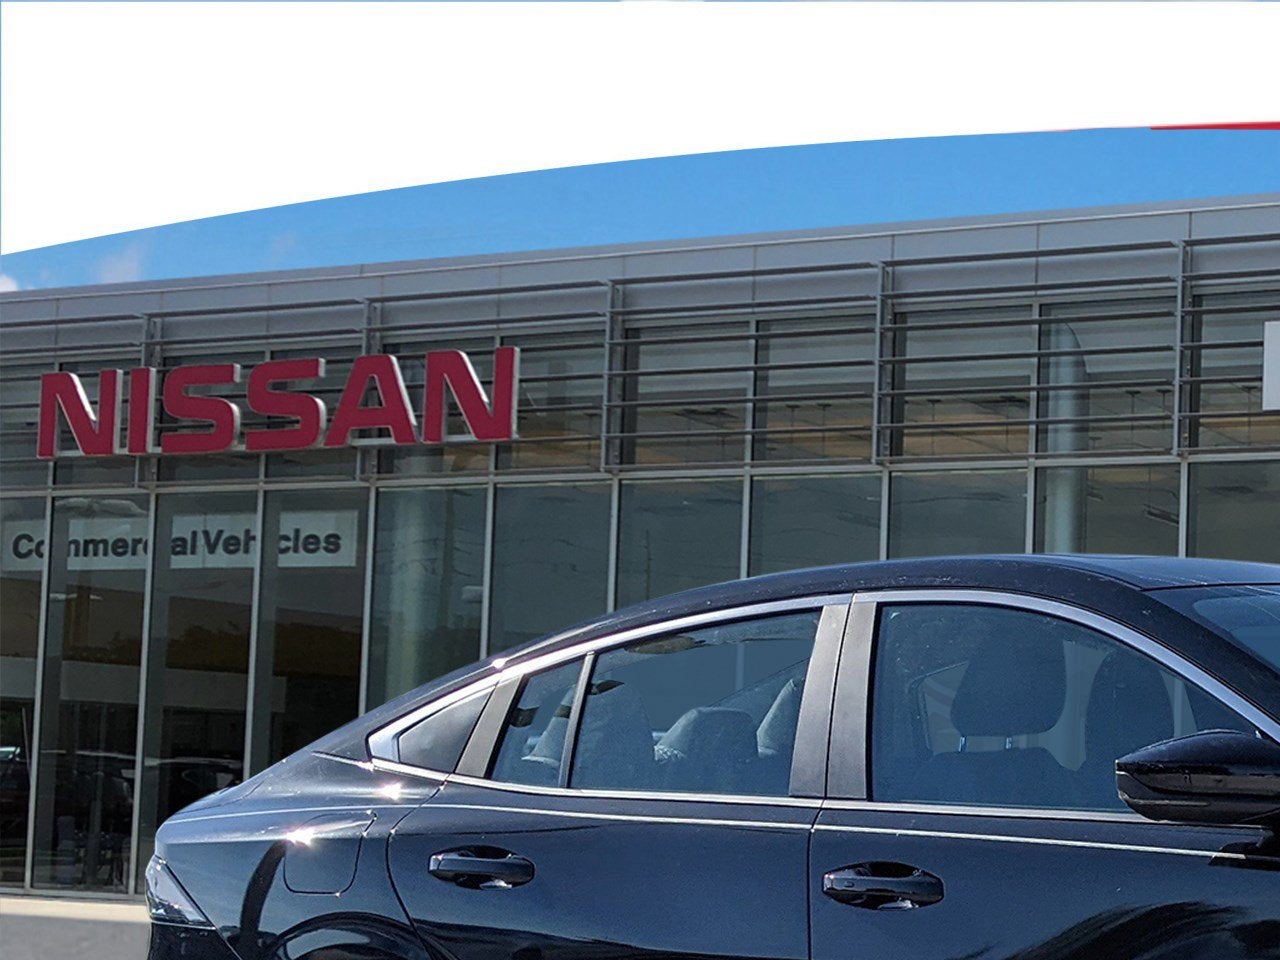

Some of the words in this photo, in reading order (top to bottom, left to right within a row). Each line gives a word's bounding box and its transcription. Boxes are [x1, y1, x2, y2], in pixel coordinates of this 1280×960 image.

[37, 346, 519, 458] NISSAN
[12, 530, 198, 558] Cmmeral
[202, 528, 342, 555] Vehcles
